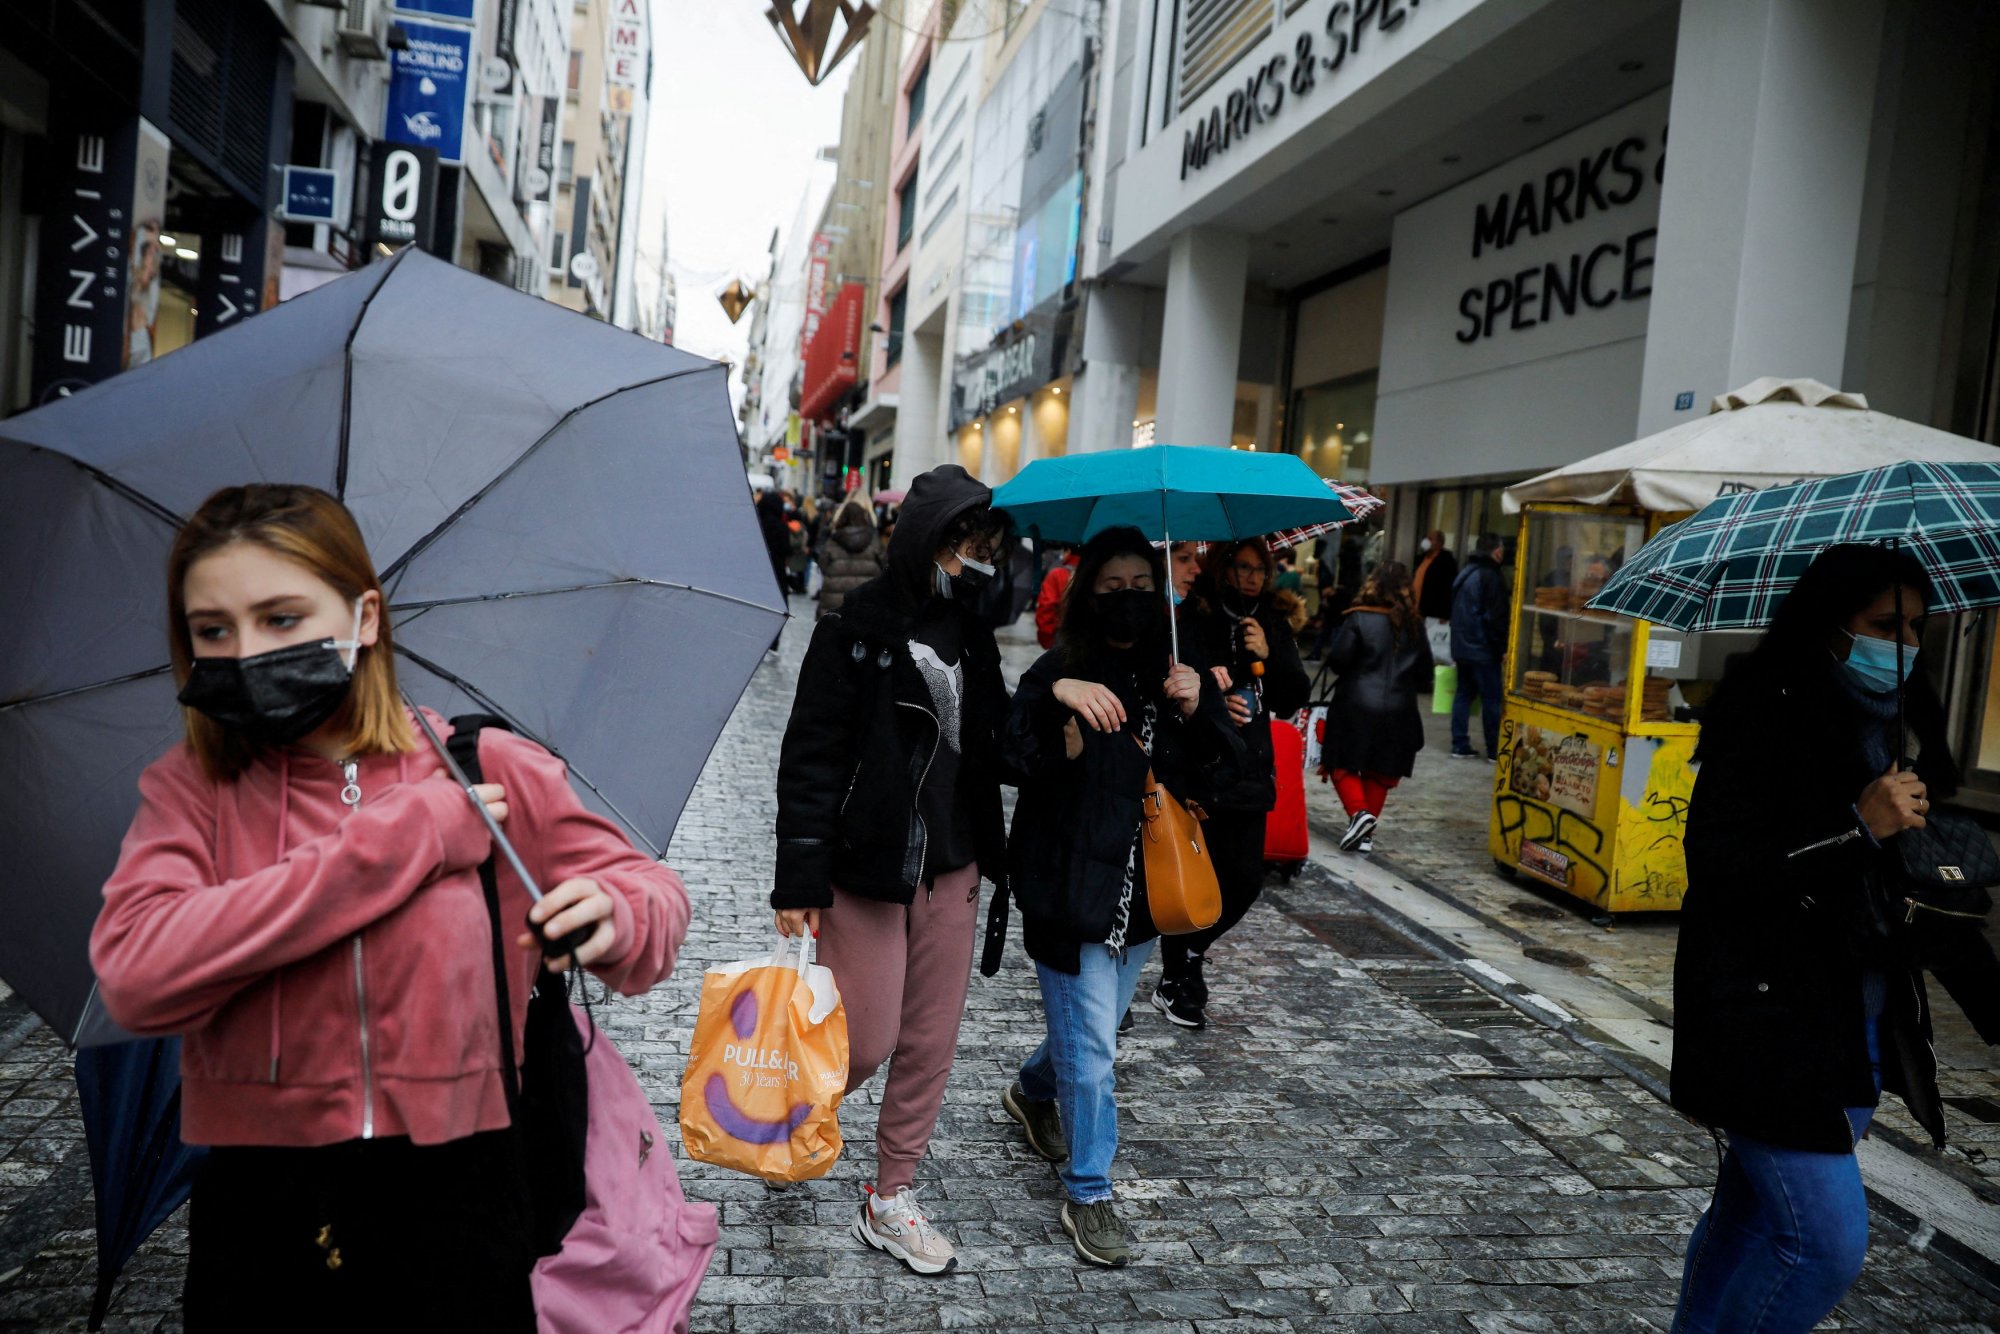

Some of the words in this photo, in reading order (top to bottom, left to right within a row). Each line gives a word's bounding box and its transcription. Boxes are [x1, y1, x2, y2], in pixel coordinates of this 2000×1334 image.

[1180, 53, 1286, 181] MARKS
[1290, 31, 1317, 97] &
[63, 135, 105, 363] ENVIE
[104, 207, 124, 297] SHOES
[1472, 137, 1645, 259] MARKS
[739, 1070, 754, 1087] 30
[756, 1072, 781, 1088] Years
